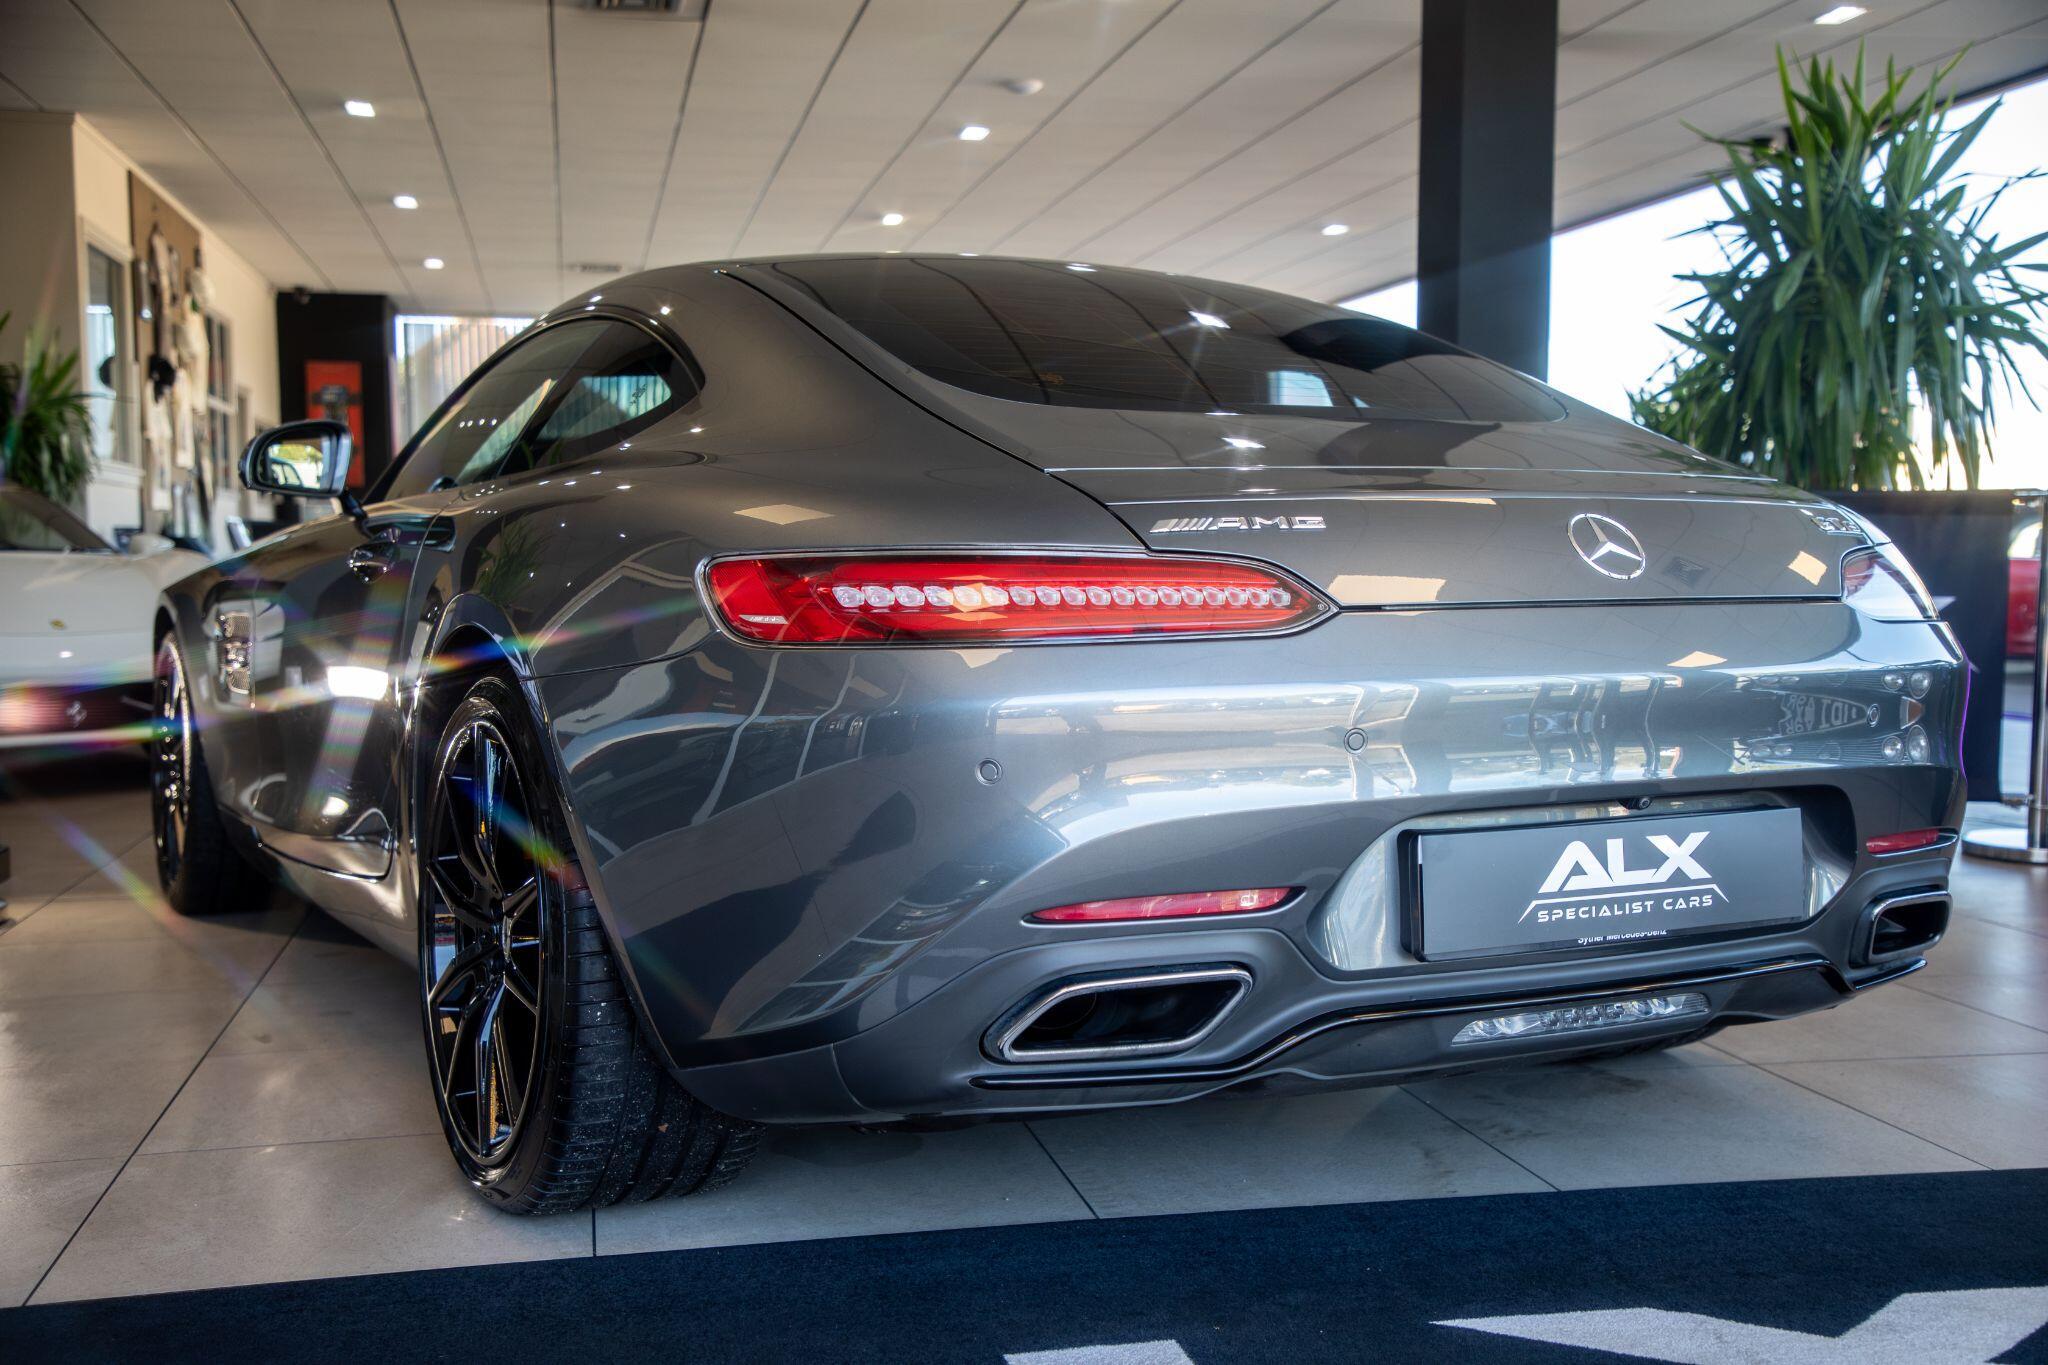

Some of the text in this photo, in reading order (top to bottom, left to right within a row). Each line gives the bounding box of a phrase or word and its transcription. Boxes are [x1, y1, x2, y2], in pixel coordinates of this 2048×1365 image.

[1208, 516, 1327, 530] AMG
[1537, 831, 1713, 894] ALX
[1537, 895, 1713, 923] SPECIALIST CARS
